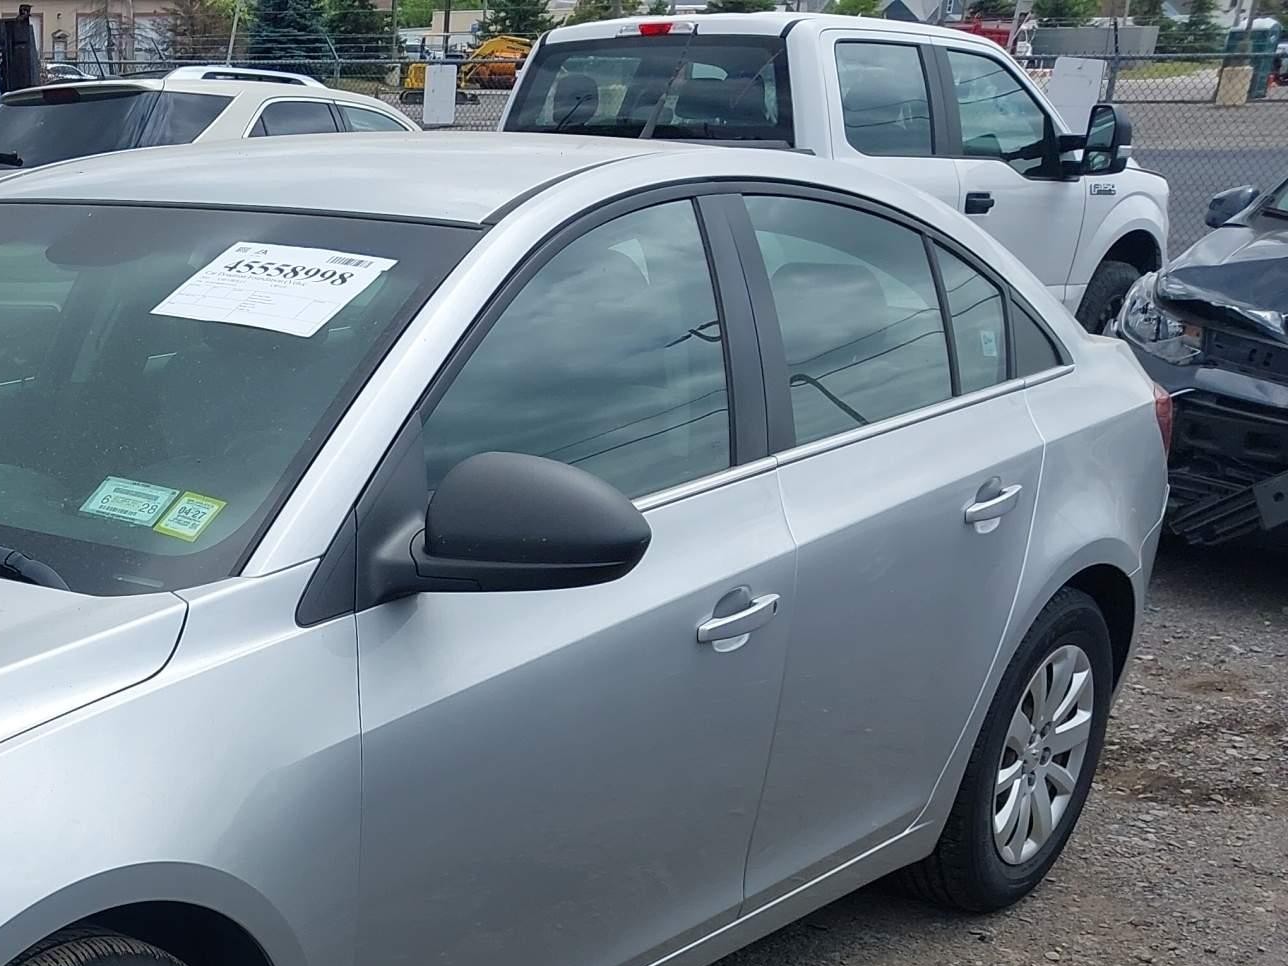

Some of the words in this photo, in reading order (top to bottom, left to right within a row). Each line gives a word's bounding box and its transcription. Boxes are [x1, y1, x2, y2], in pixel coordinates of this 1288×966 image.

[223, 258, 354, 286] 45558998
[100, 494, 112, 504] 6
[138, 502, 159, 515] 28
[177, 506, 208, 520] 04-27
